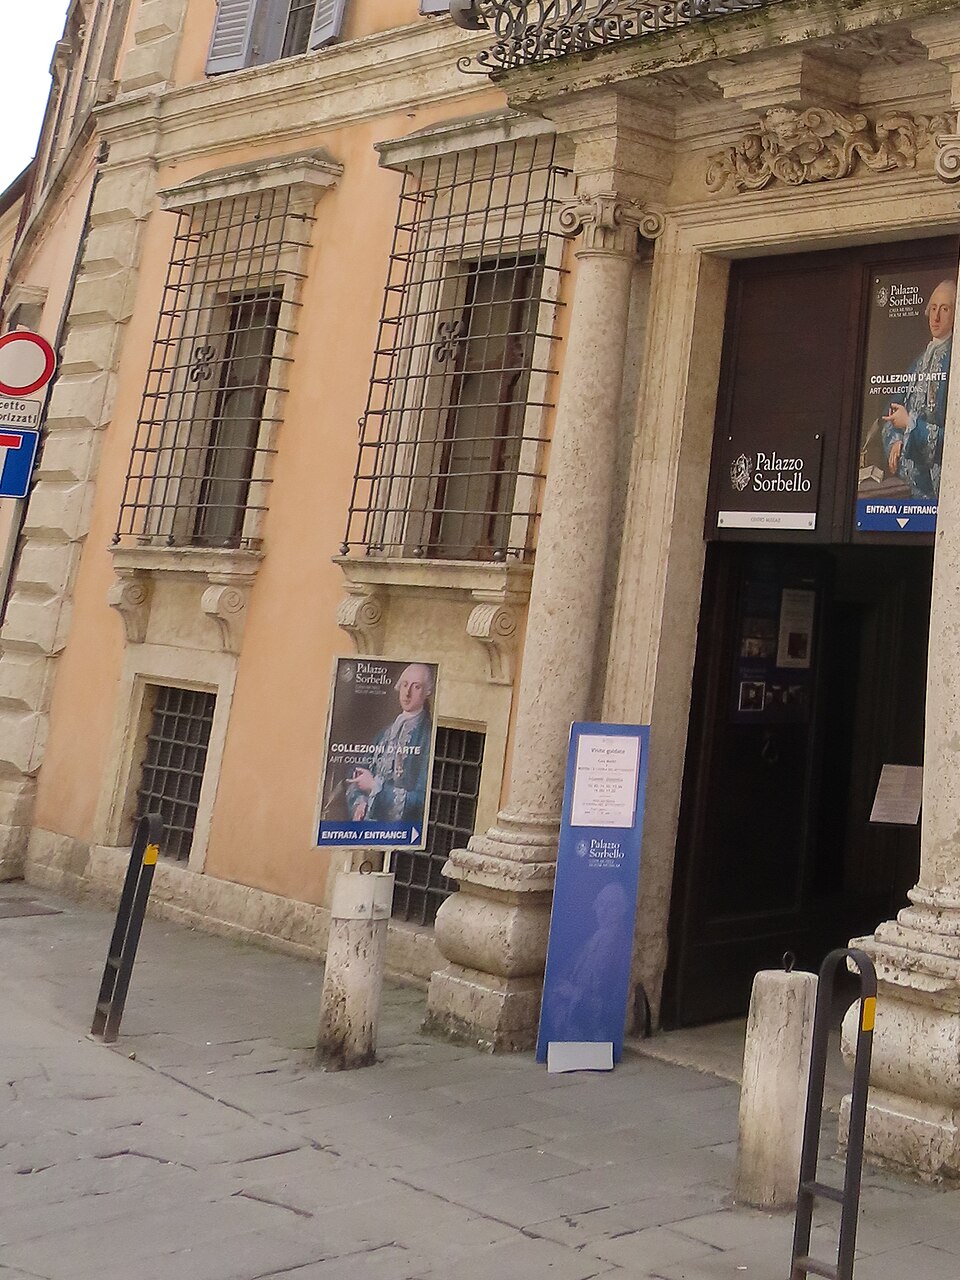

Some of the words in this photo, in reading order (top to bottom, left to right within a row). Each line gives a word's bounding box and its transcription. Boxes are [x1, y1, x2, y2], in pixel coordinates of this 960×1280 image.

[890, 283, 919, 296] Palazzo
[889, 294, 924, 307] Sorbello
[870, 374, 917, 384] COLLEZIONI
[918, 372, 947, 381] D'ARTE
[755, 451, 804, 471] Palazzo
[753, 472, 811, 492] Sorbello
[866, 505, 897, 514] ENTRATA
[903, 505, 938, 514] ENTRANC
[356, 663, 388, 674] Palazzo
[355, 673, 392, 685] Sorbello
[331, 743, 385, 754] COLLEZIONI
[386, 745, 421, 755] D'ARTE
[329, 755, 344, 763] ART
[321, 830, 358, 839] ENTRATA
[364, 831, 408, 839] ENTRANCE
[590, 839, 620, 849] Palazzo
[589, 848, 625, 859] Sorbello
